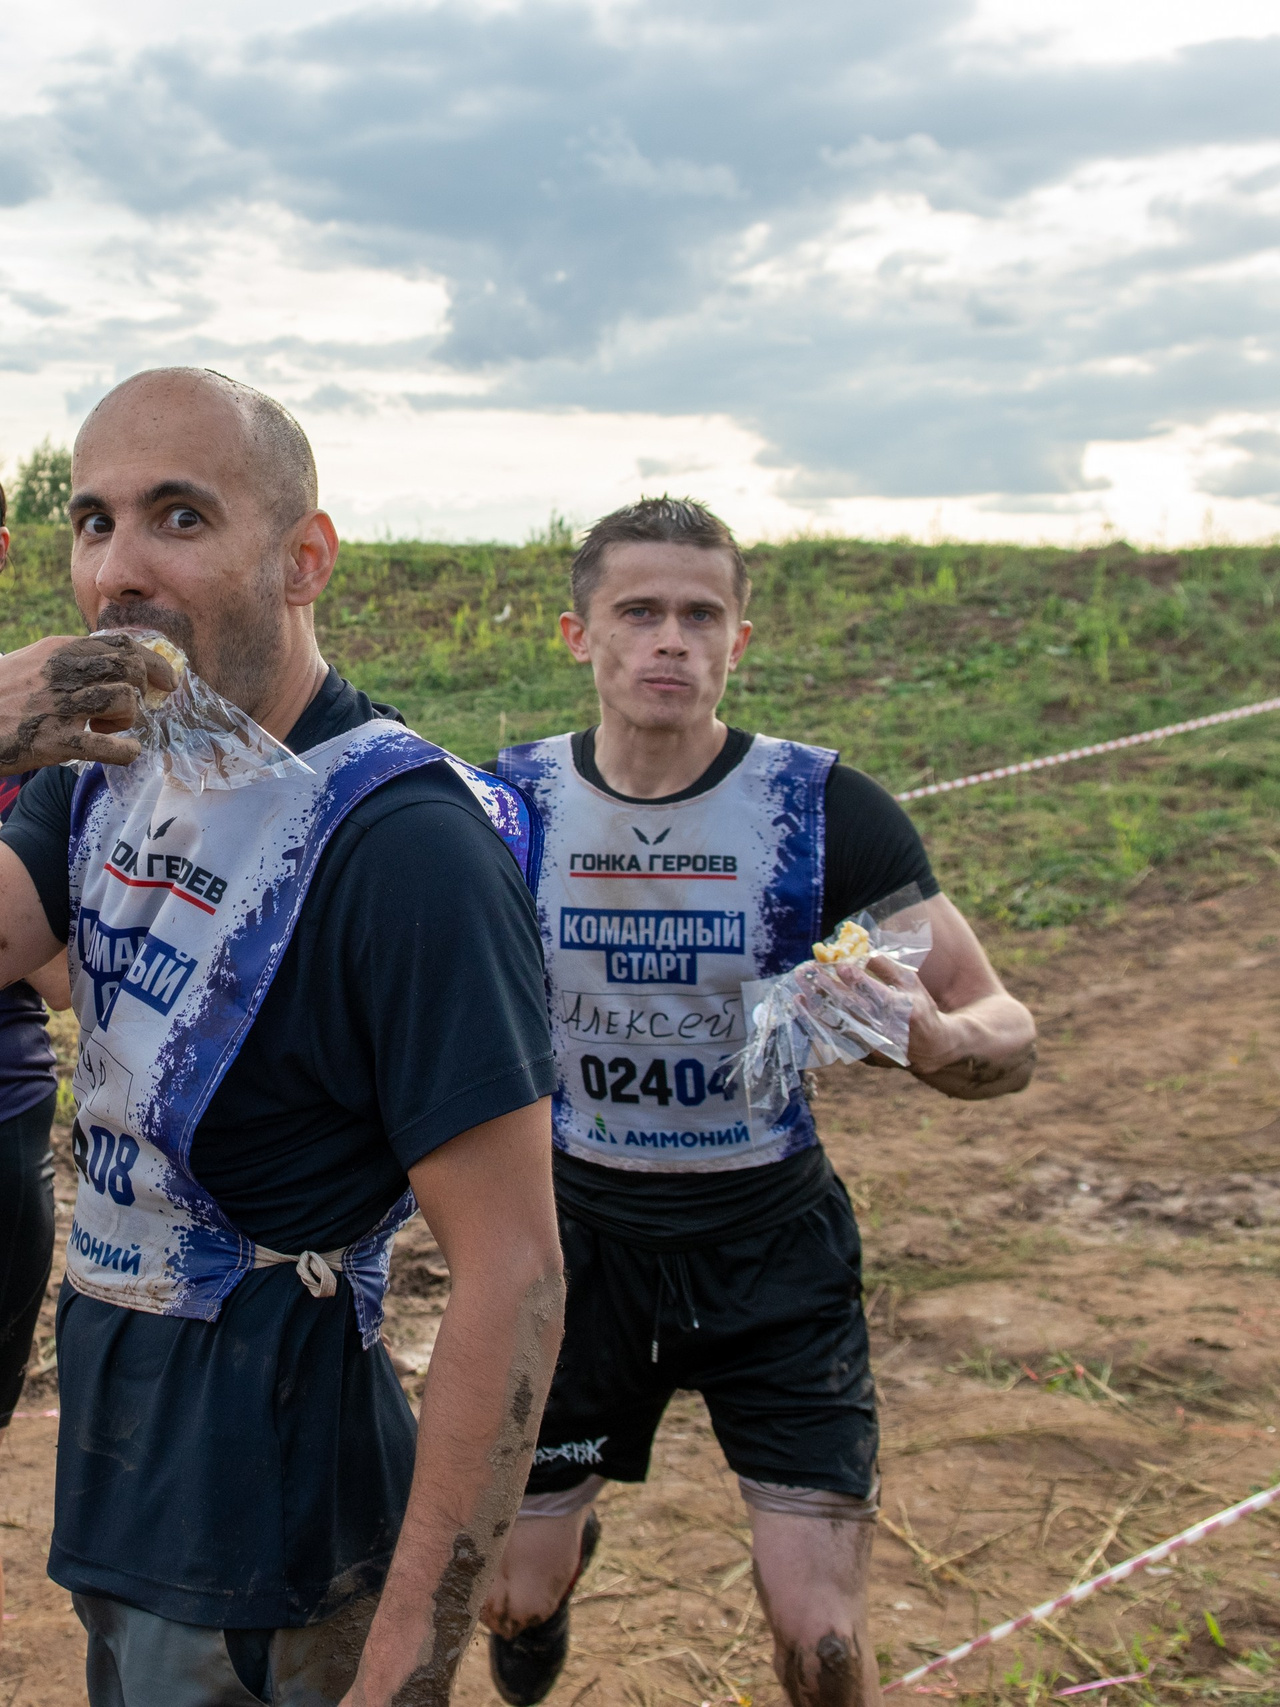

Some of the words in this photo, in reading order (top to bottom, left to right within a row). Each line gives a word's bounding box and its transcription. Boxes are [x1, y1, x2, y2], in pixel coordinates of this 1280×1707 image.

[570, 853, 641, 873] ГОНКА
[648, 854, 738, 873] ГЕРОЕВ
[563, 911, 743, 951] КОМАНДНЫЙ
[611, 952, 691, 981] СТАРТ
[624, 1121, 751, 1148] АММОНИЙ
